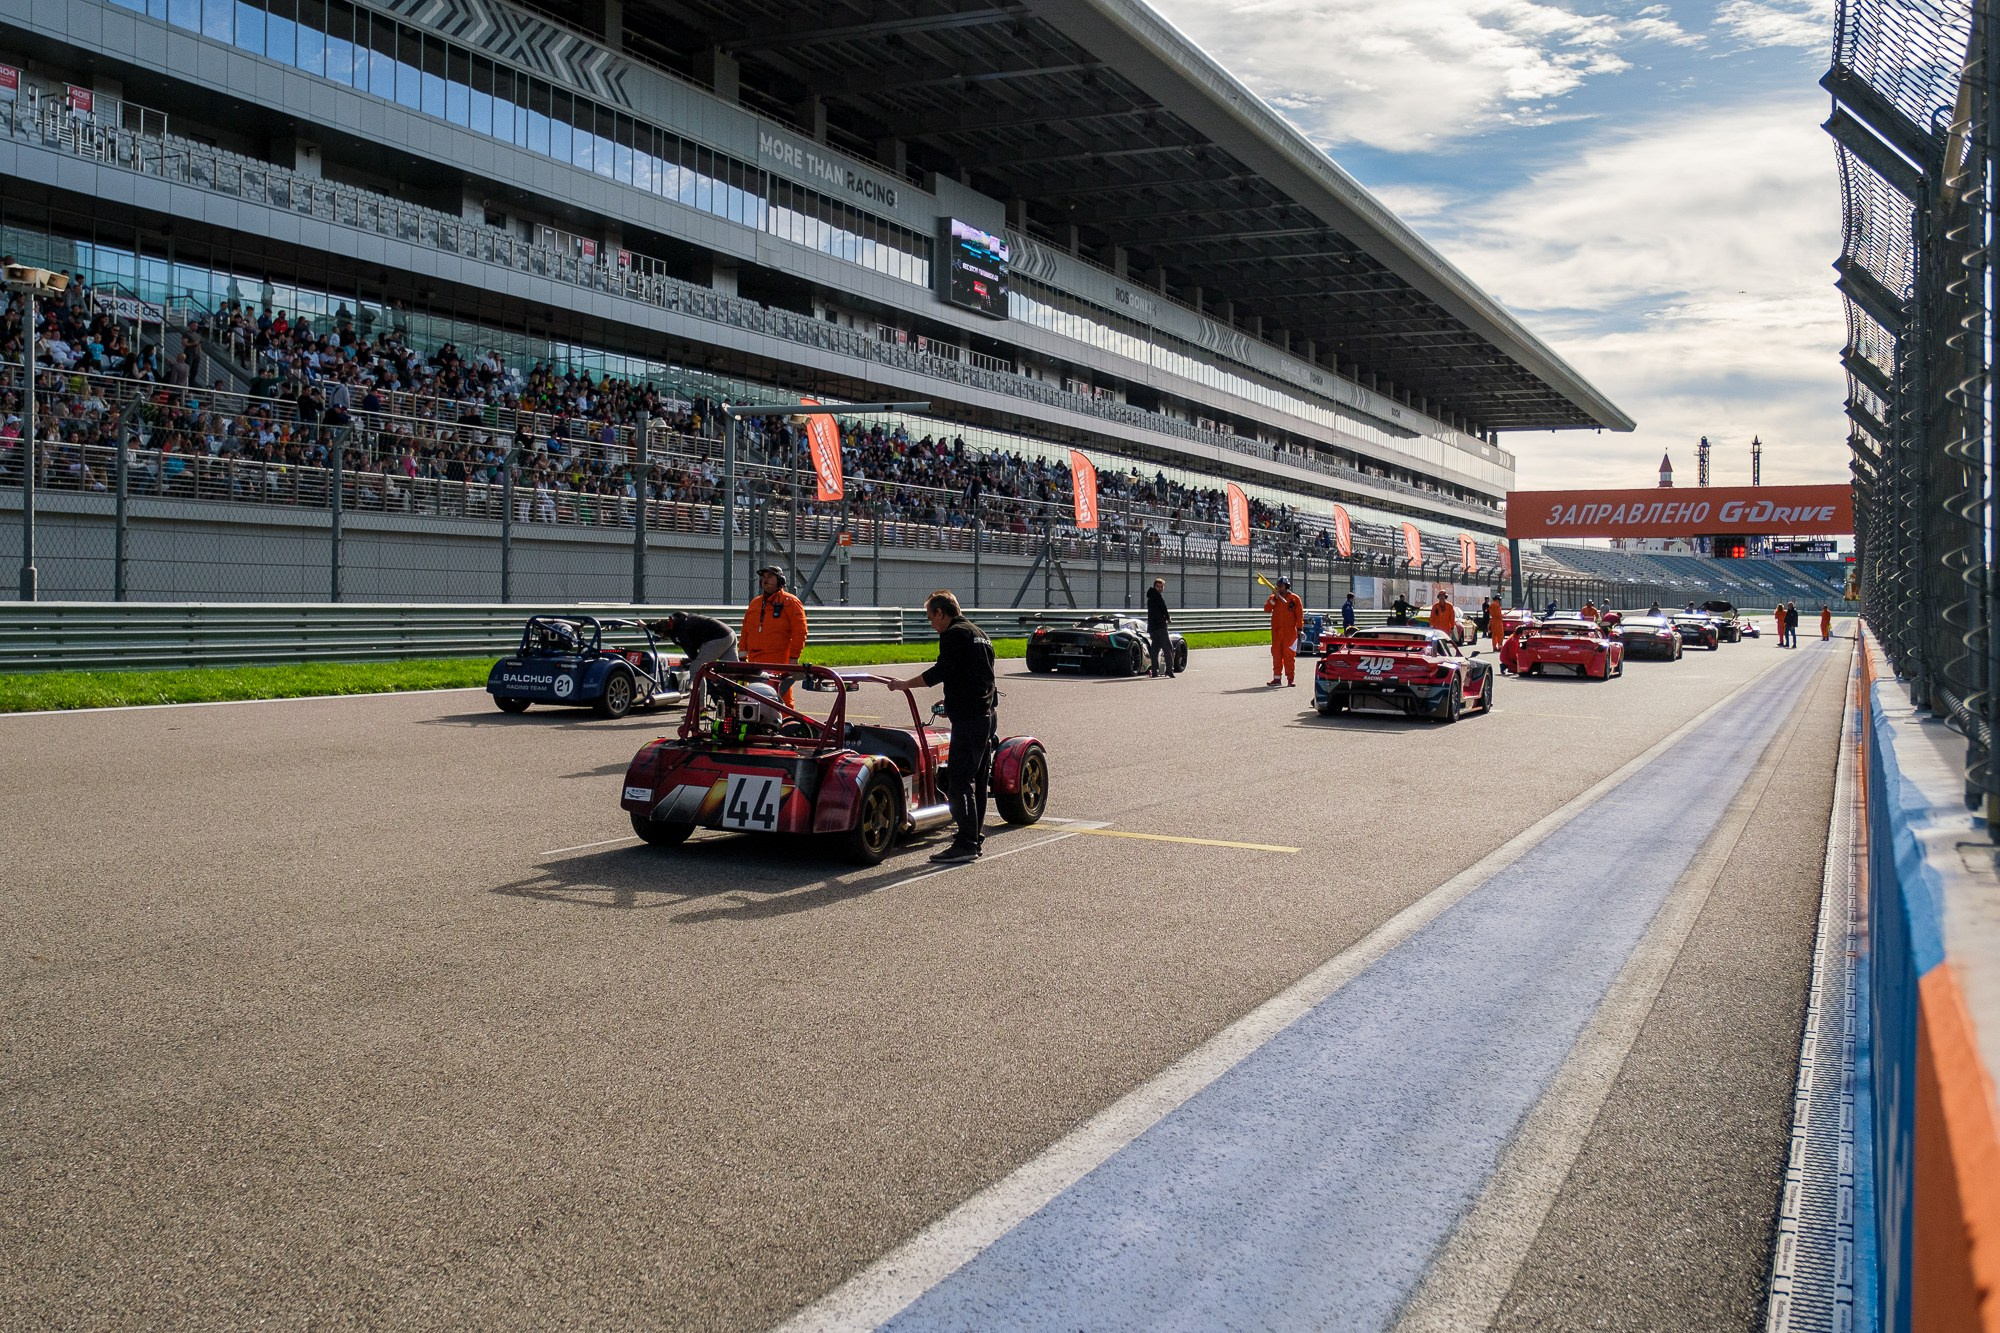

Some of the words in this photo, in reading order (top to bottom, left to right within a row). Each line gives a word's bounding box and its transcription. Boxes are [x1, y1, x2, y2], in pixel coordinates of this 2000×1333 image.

[760, 131, 803, 169] MORE
[806, 153, 844, 186] THAN
[846, 170, 898, 209] RACING!
[1115, 287, 1152, 314] ROSGONKI
[1546, 502, 1710, 525] ЗАПРАВЛЕНО
[1357, 656, 1395, 671] ZUB
[503, 673, 553, 684] BALCHUG
[556, 679, 570, 693] 21
[726, 777, 775, 829] 44
